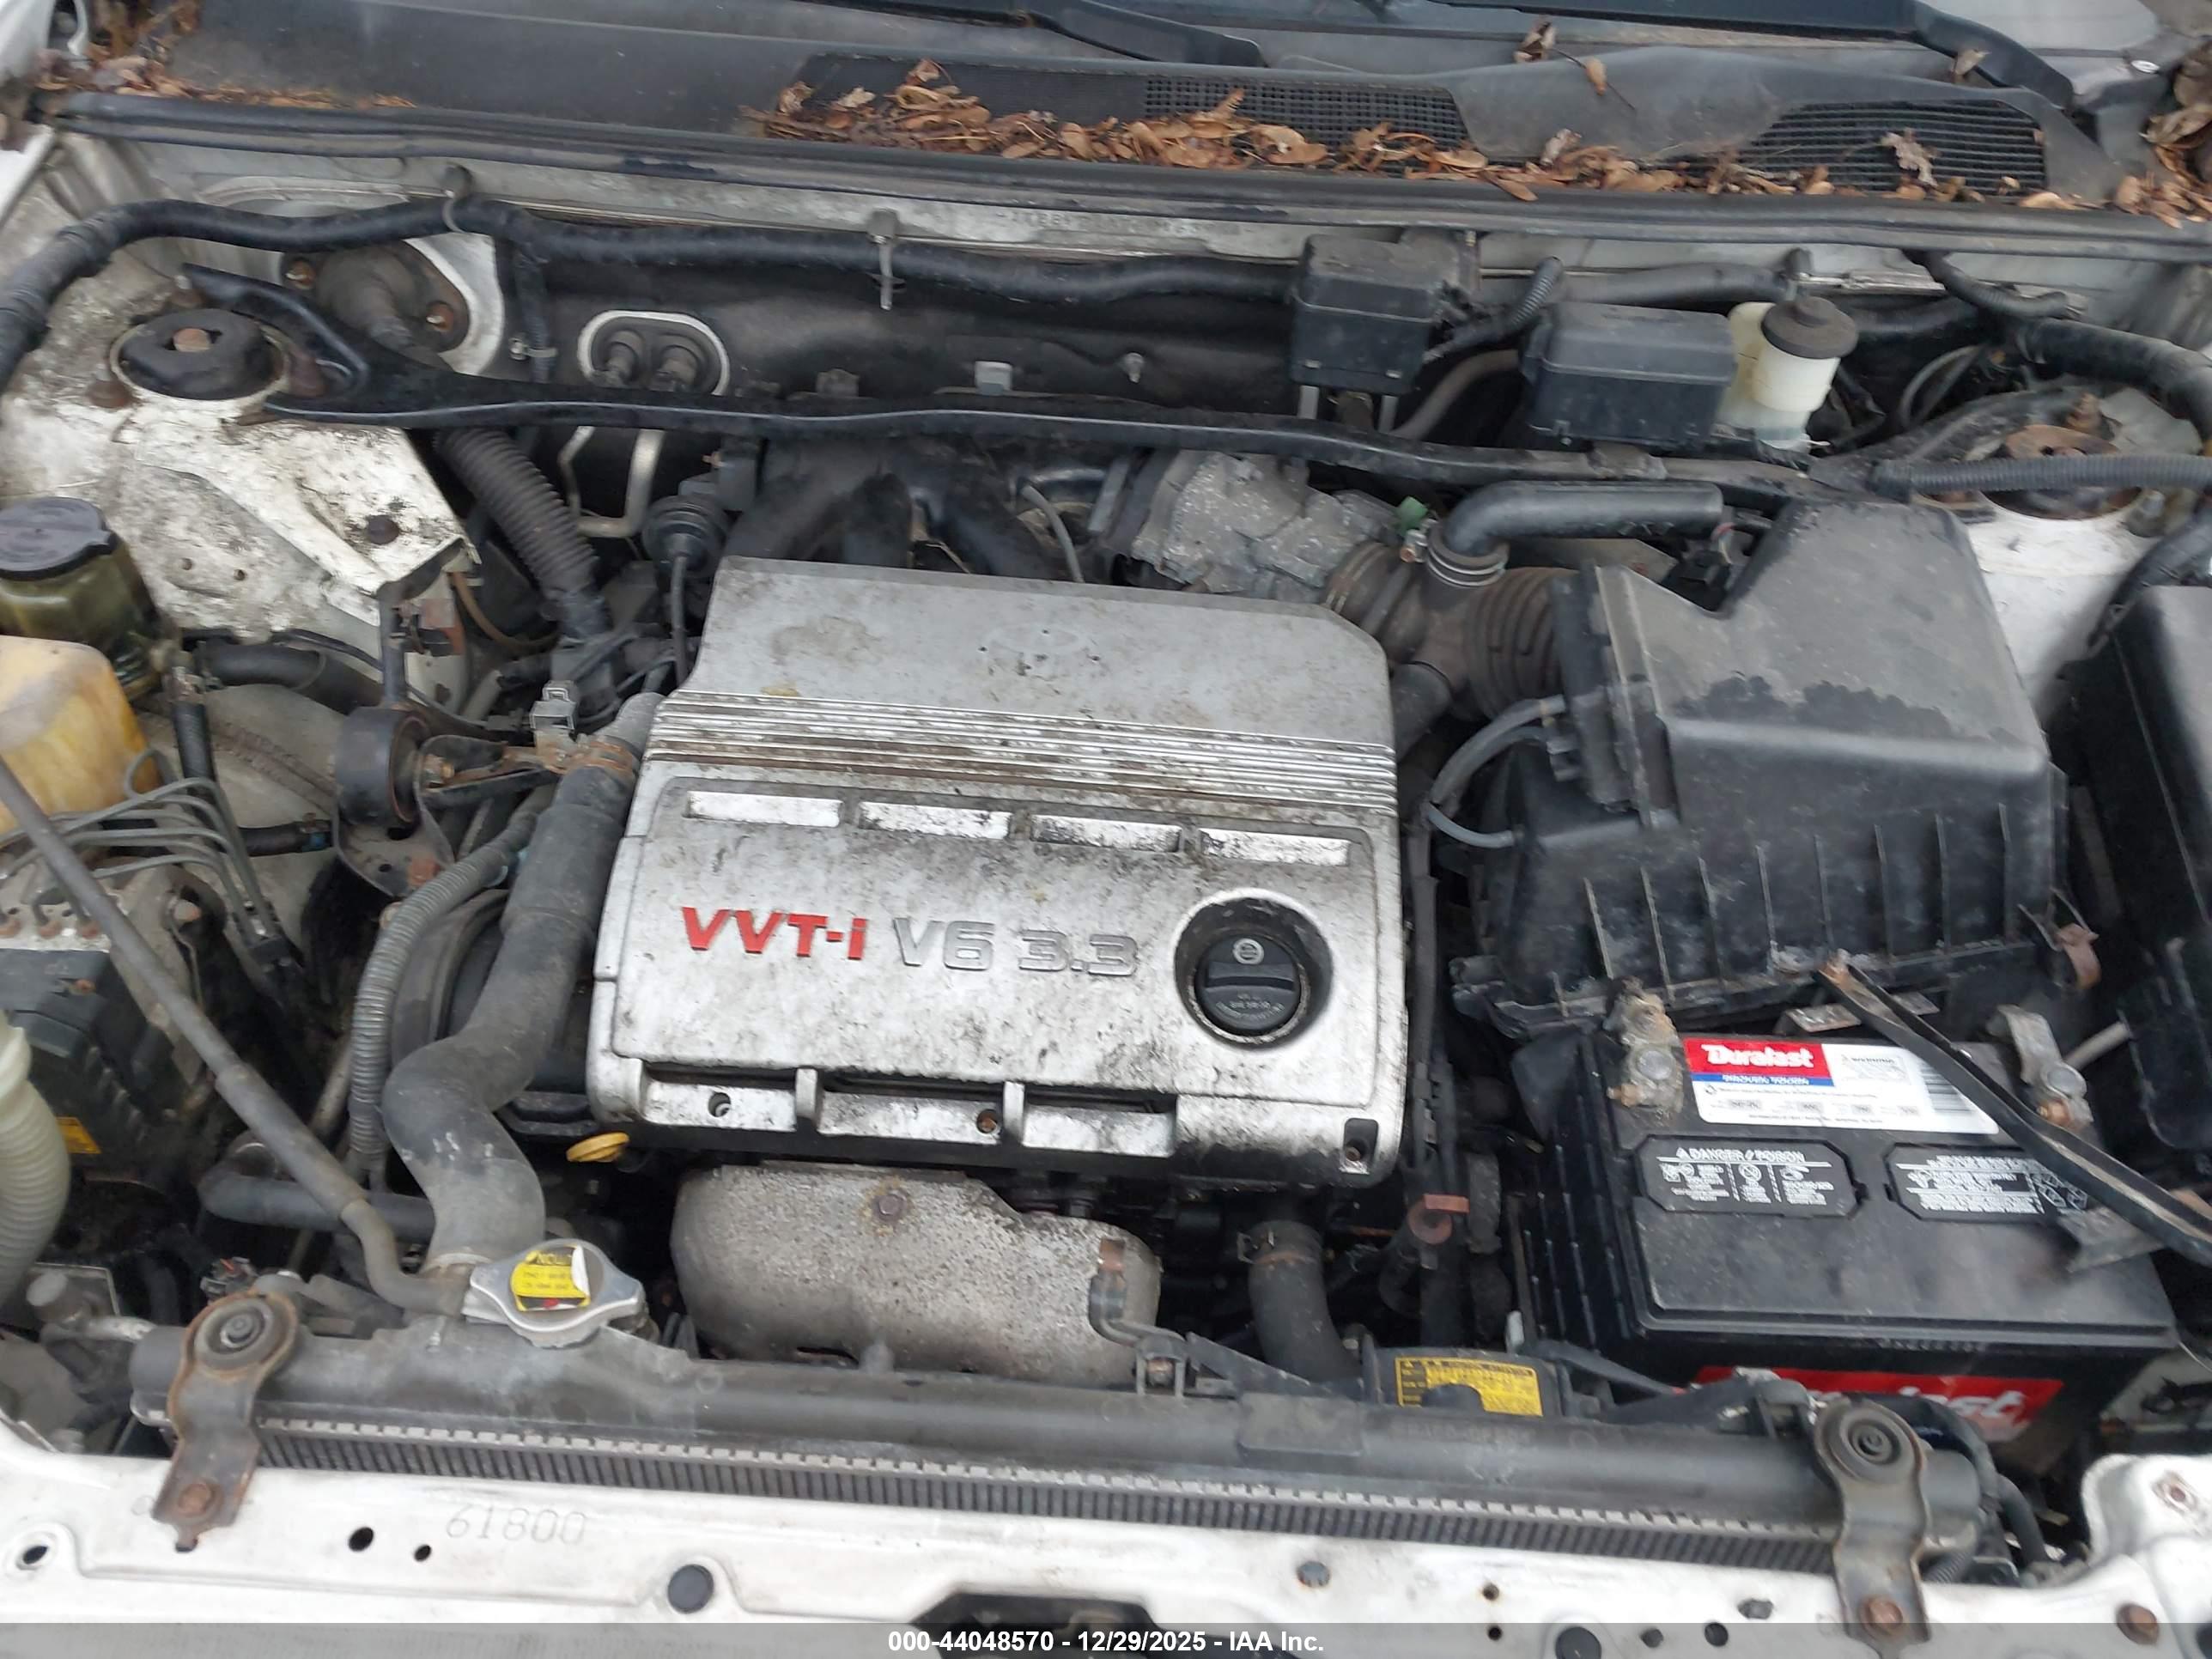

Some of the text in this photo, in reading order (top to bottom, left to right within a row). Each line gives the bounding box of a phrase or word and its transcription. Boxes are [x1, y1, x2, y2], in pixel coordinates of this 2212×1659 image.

[681, 906, 1139, 976] VVT-i V6 3.3
[1700, 1043, 1814, 1068] Duralast
[1688, 1148, 1746, 1161] DANGER
[1754, 1150, 1806, 1163] POISON
[446, 1504, 587, 1544] 61800
